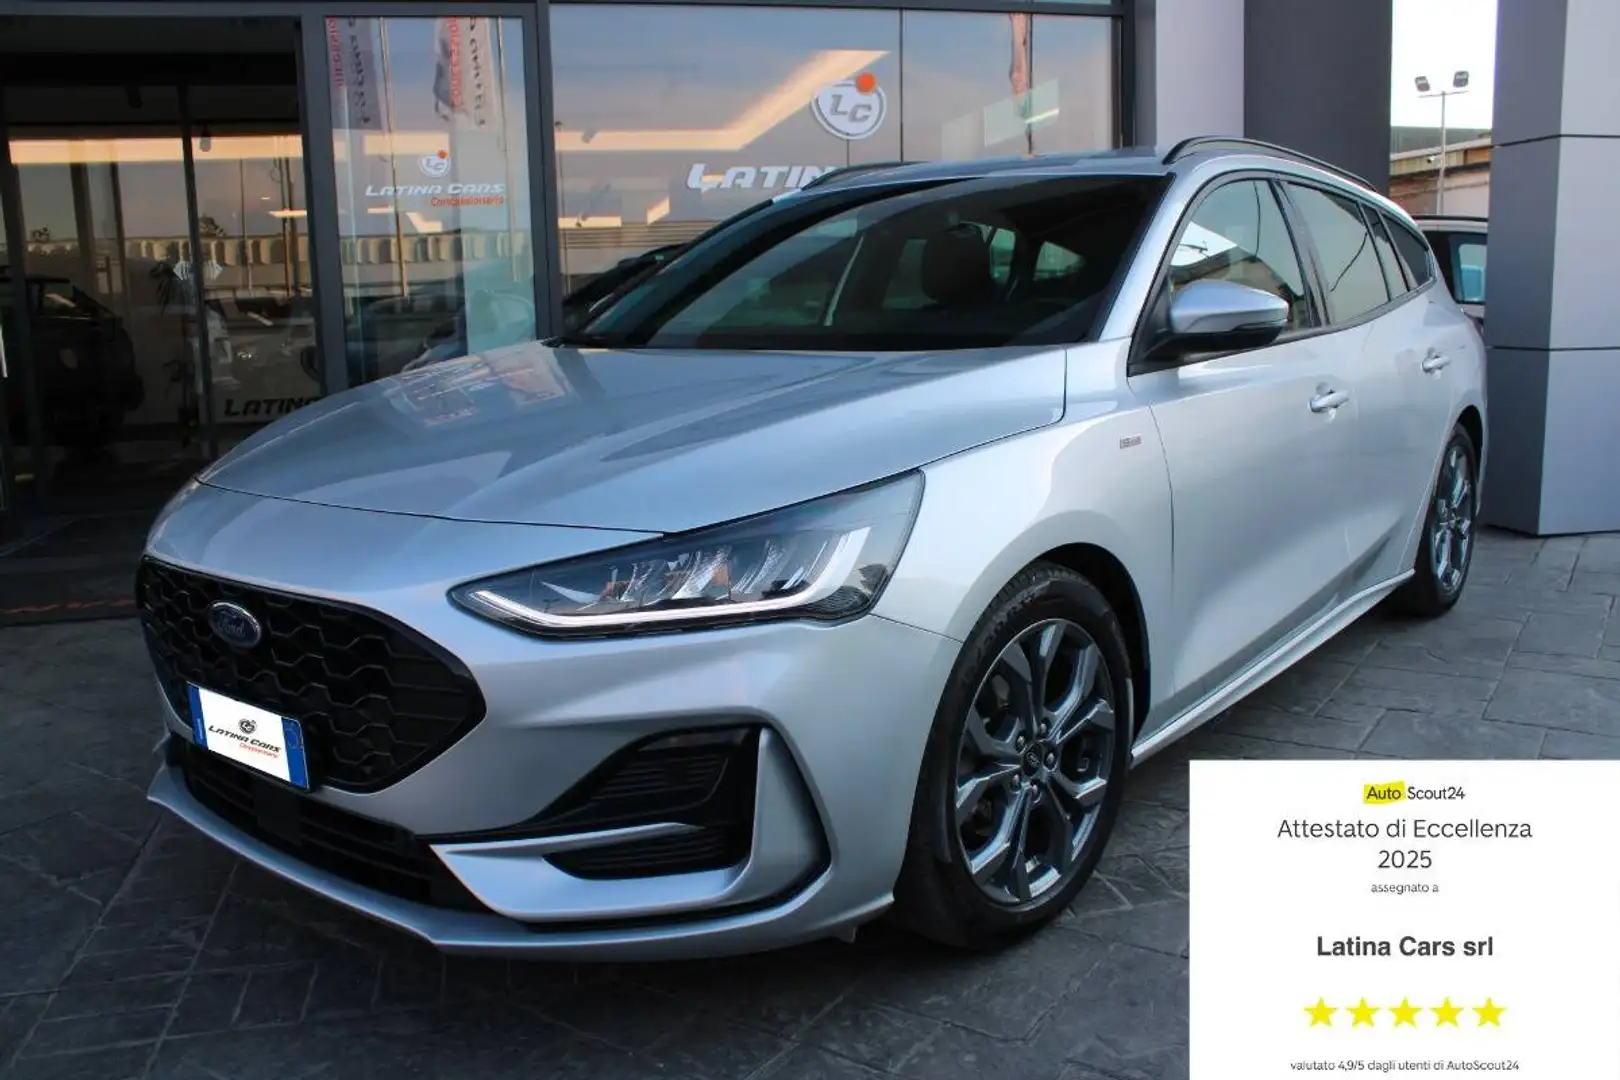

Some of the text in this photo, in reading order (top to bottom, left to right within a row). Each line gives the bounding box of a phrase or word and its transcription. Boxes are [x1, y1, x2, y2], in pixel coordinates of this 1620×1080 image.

[828, 93, 873, 123] LC
[365, 182, 507, 198] LATINA CARS
